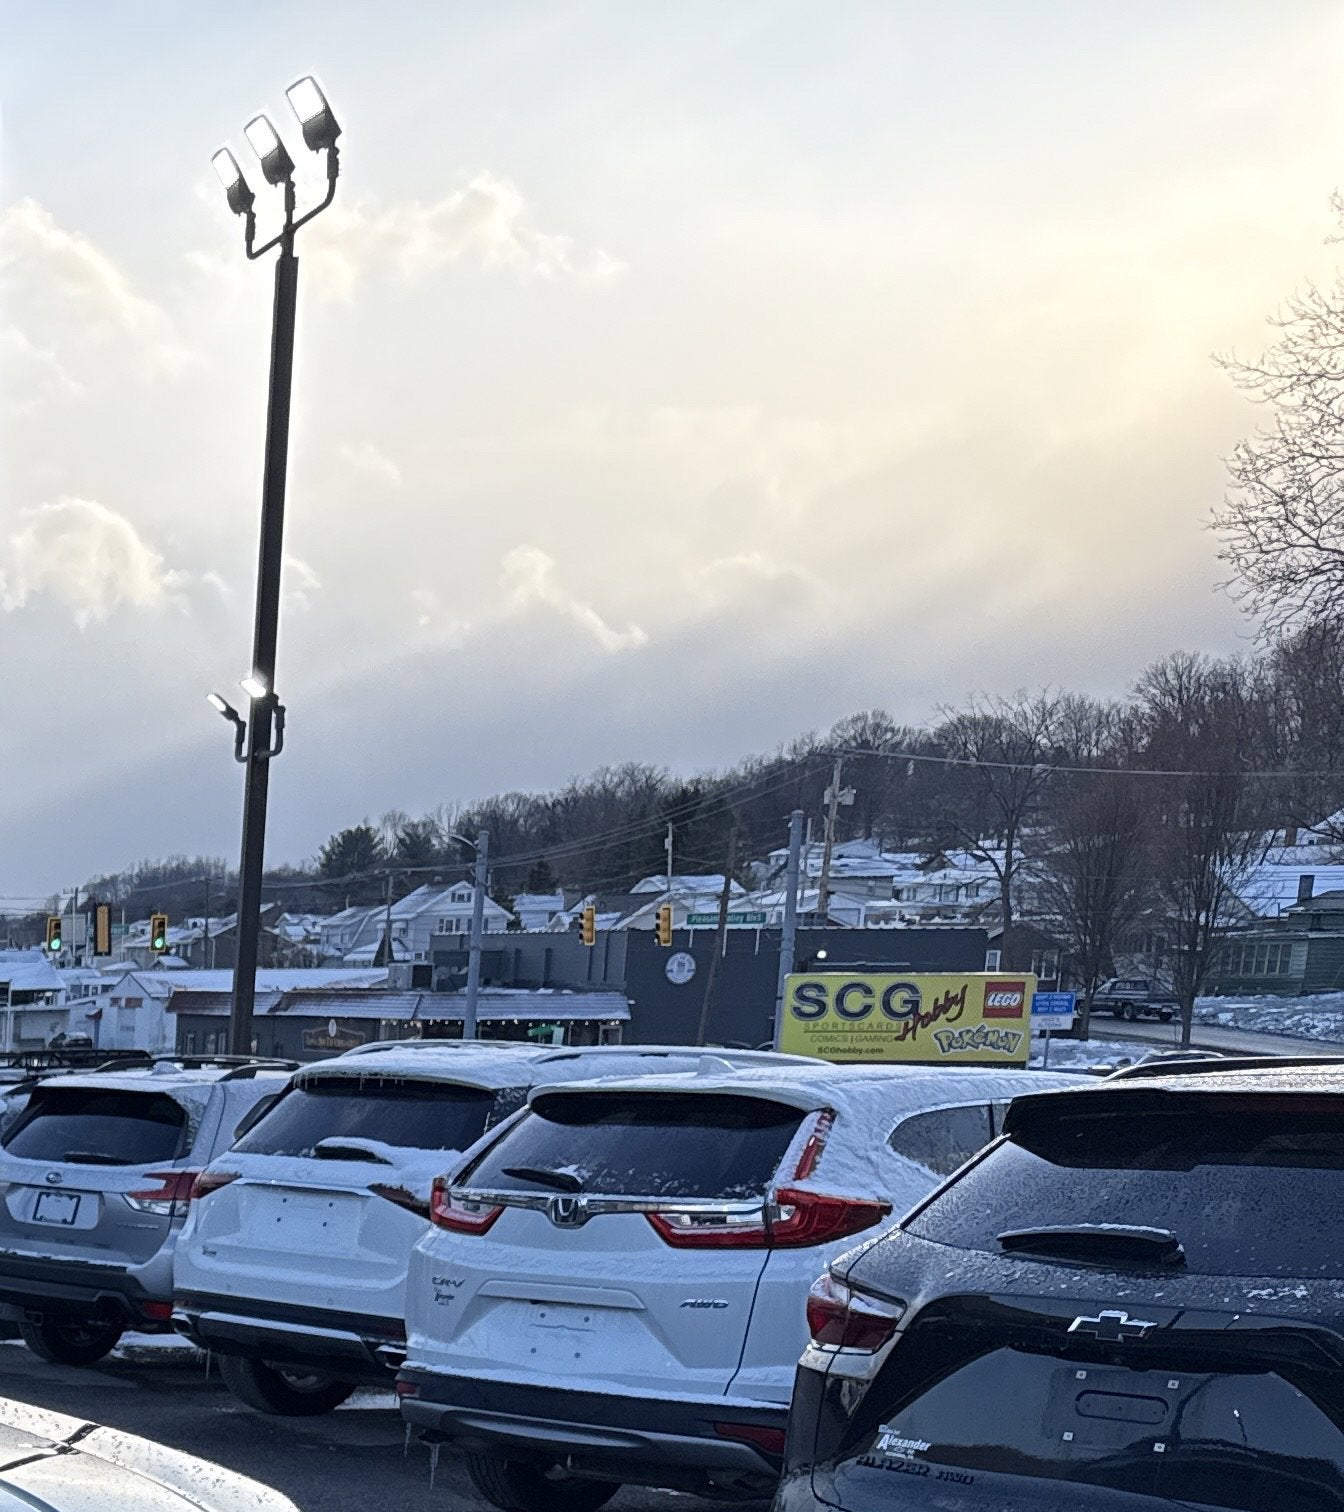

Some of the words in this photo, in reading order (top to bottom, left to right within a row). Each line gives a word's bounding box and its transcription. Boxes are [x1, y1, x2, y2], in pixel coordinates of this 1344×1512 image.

[987, 990, 1023, 1009] LEGO
[791, 981, 922, 1022] SCG
[894, 984, 969, 1041] Hobby
[803, 1022, 902, 1031] SPORTSCARDS
[679, 1298, 730, 1310] AWD
[875, 1433, 932, 1452] Alexander
